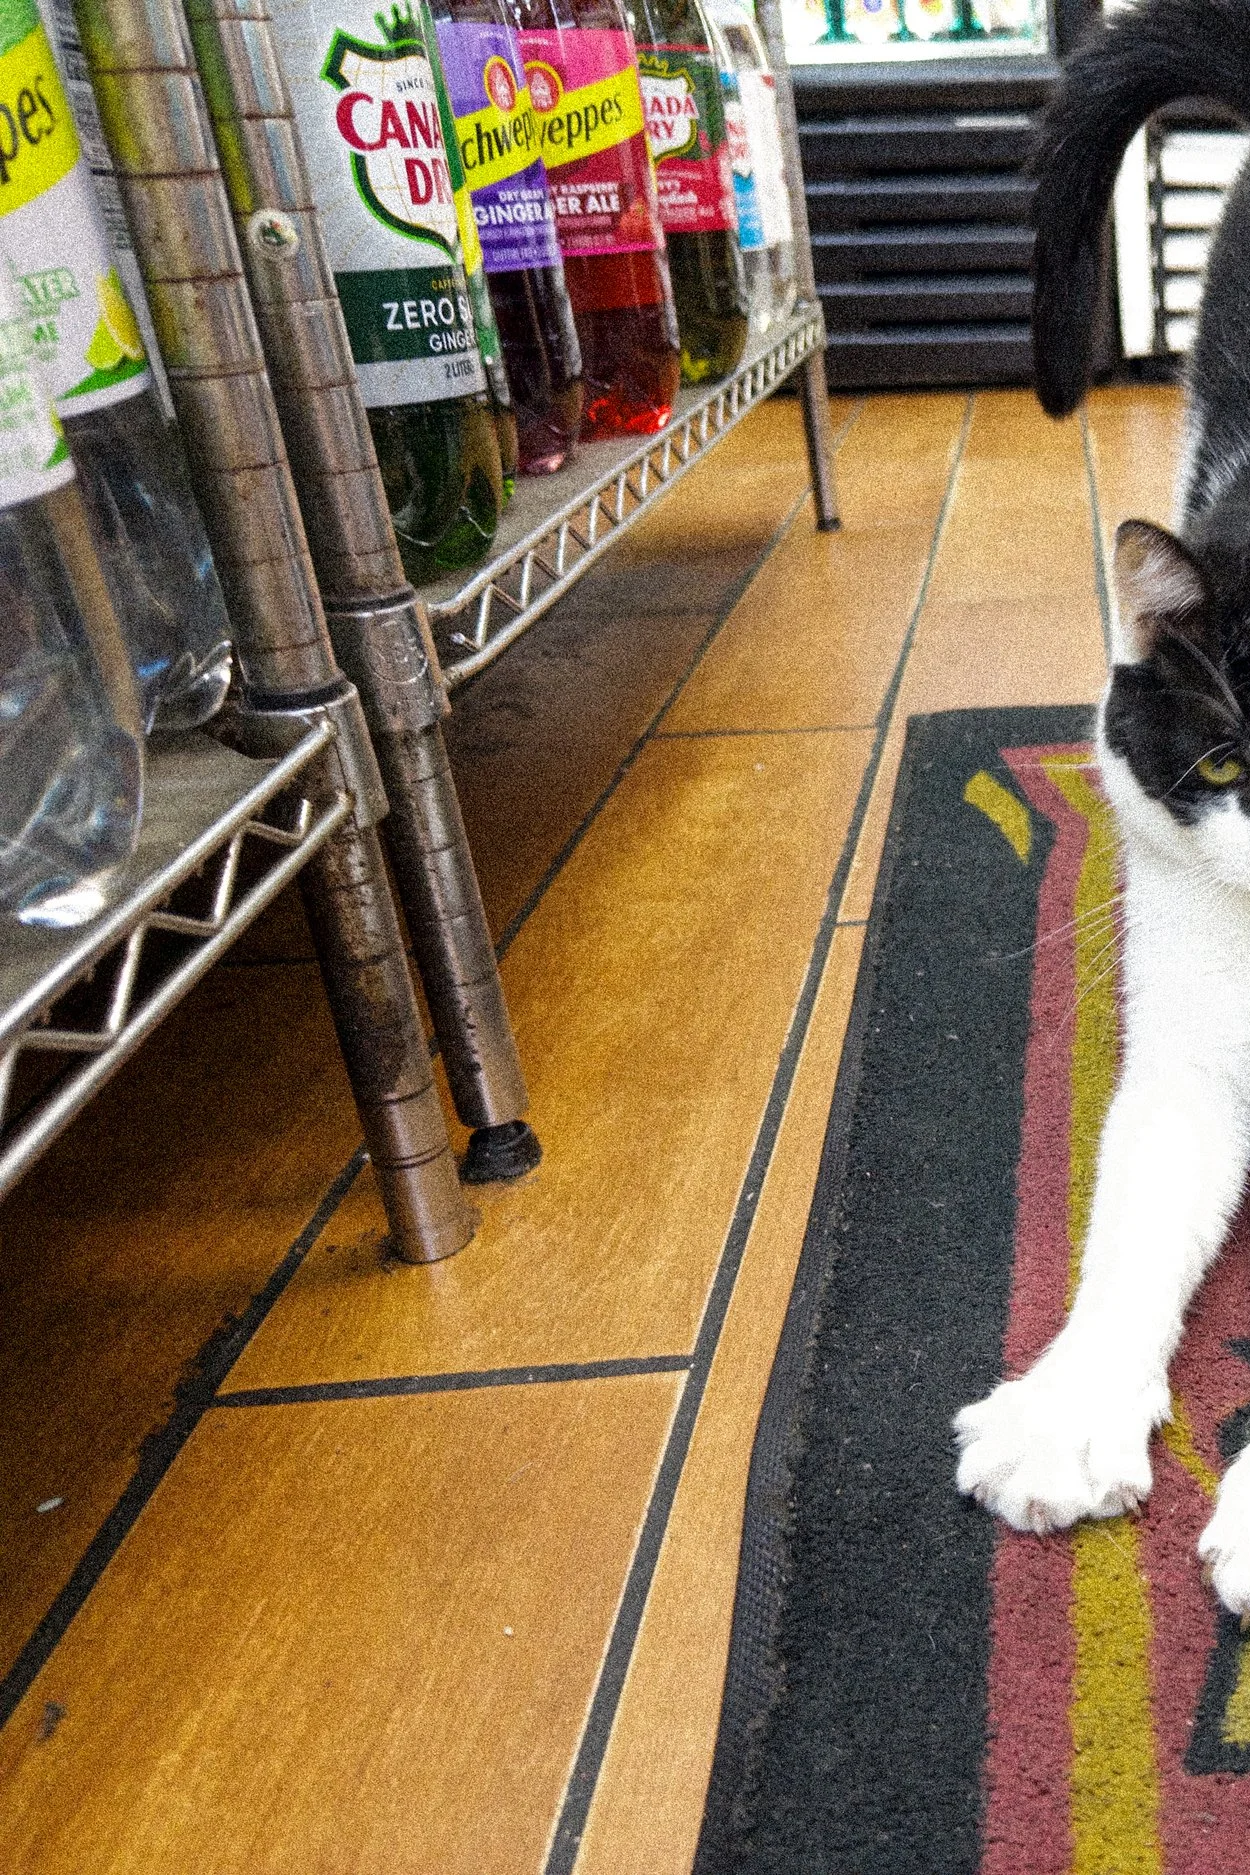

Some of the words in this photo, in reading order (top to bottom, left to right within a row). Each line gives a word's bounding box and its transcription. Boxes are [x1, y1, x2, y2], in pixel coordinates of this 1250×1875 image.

[644, 96, 696, 115] ADA
[474, 201, 543, 227] GINGER
[586, 193, 621, 214] ALE
[382, 297, 455, 331] ZERO
